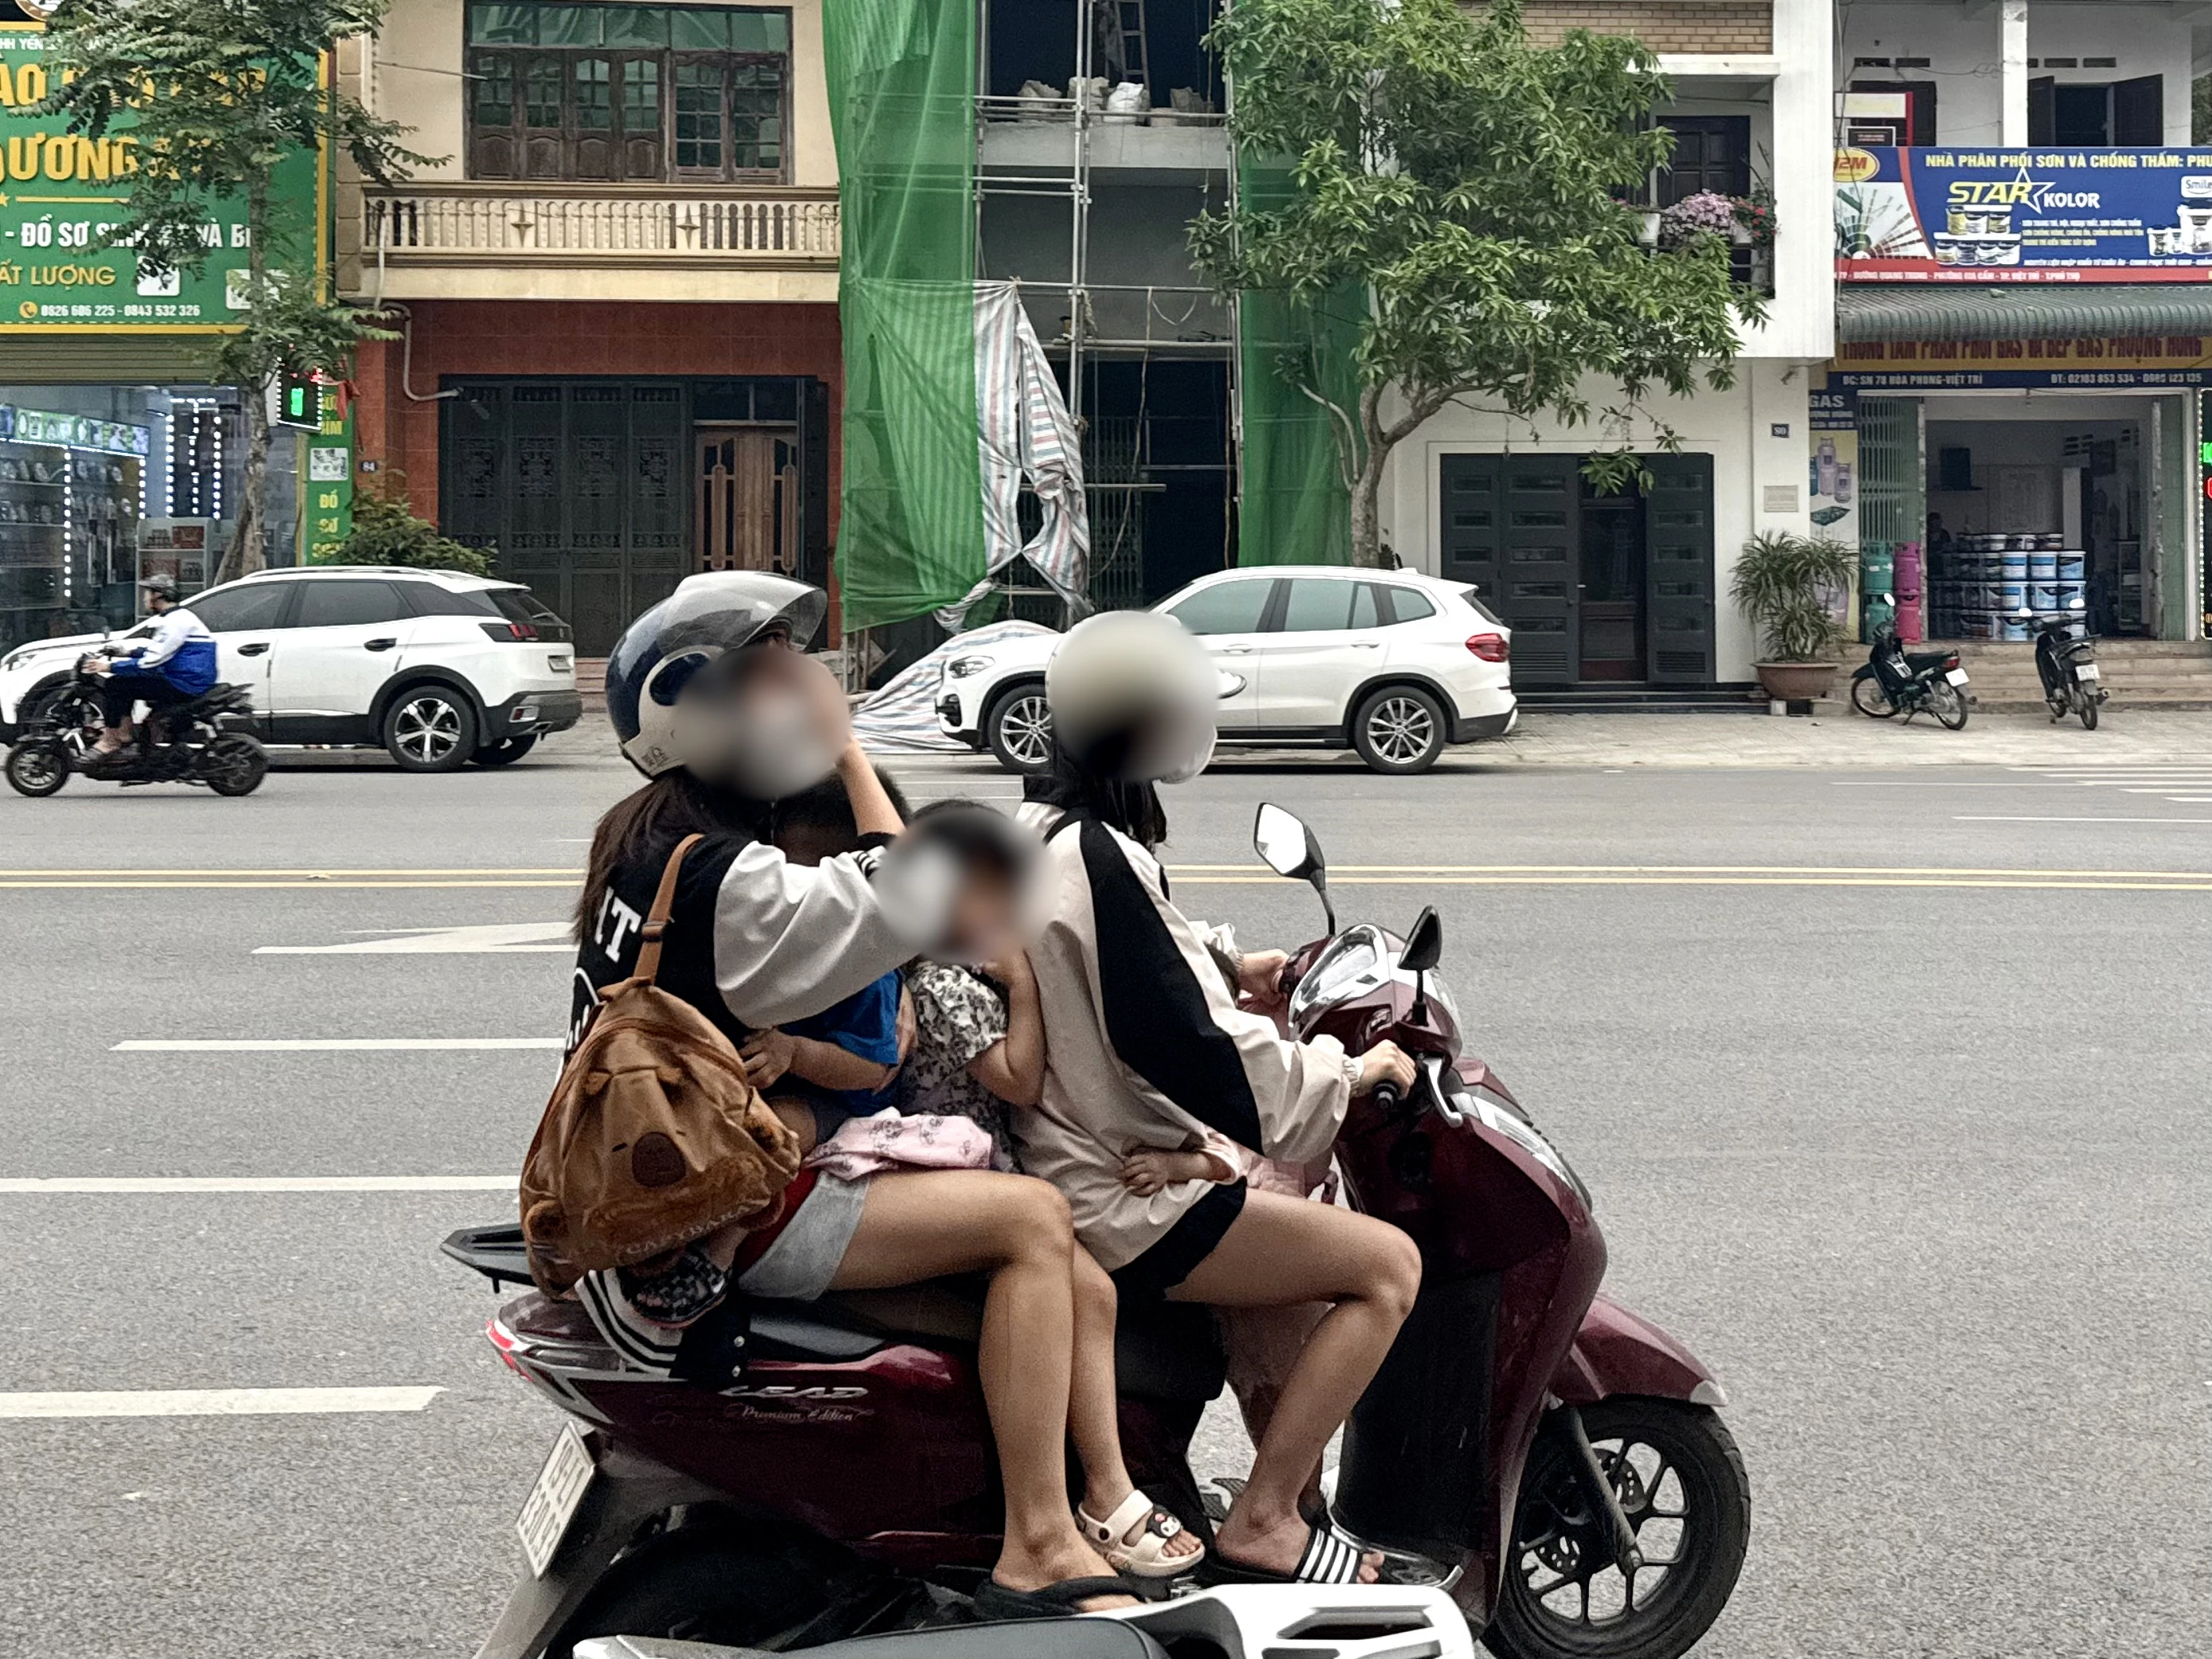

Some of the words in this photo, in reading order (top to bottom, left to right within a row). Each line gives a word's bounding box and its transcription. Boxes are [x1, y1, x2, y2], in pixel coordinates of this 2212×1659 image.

[0, 132, 139, 182] ƯƠNG
[1926, 151, 1954, 167] NHÀ
[1958, 152, 1996, 167] PHÂN
[2000, 151, 2032, 167] PHỐI
[2035, 154, 2065, 167] SƠN
[2069, 152, 2086, 167] VÀ
[2090, 151, 2137, 167] CHỐNG
[1945, 181, 2033, 204] STAR
[2043, 193, 2100, 208] KOLOR
[21, 213, 52, 247] ĐỒ
[58, 220, 91, 247] SƠ
[30, 264, 116, 290] LƯỢNG
[94, 305, 115, 317] 225
[155, 305, 177, 317] 532
[178, 305, 201, 317] 326
[1809, 395, 1844, 407] GAS
[718, 1385, 869, 1399] LEAD
[741, 1404, 802, 1421] Premium
[806, 1407, 855, 1422] Edition
